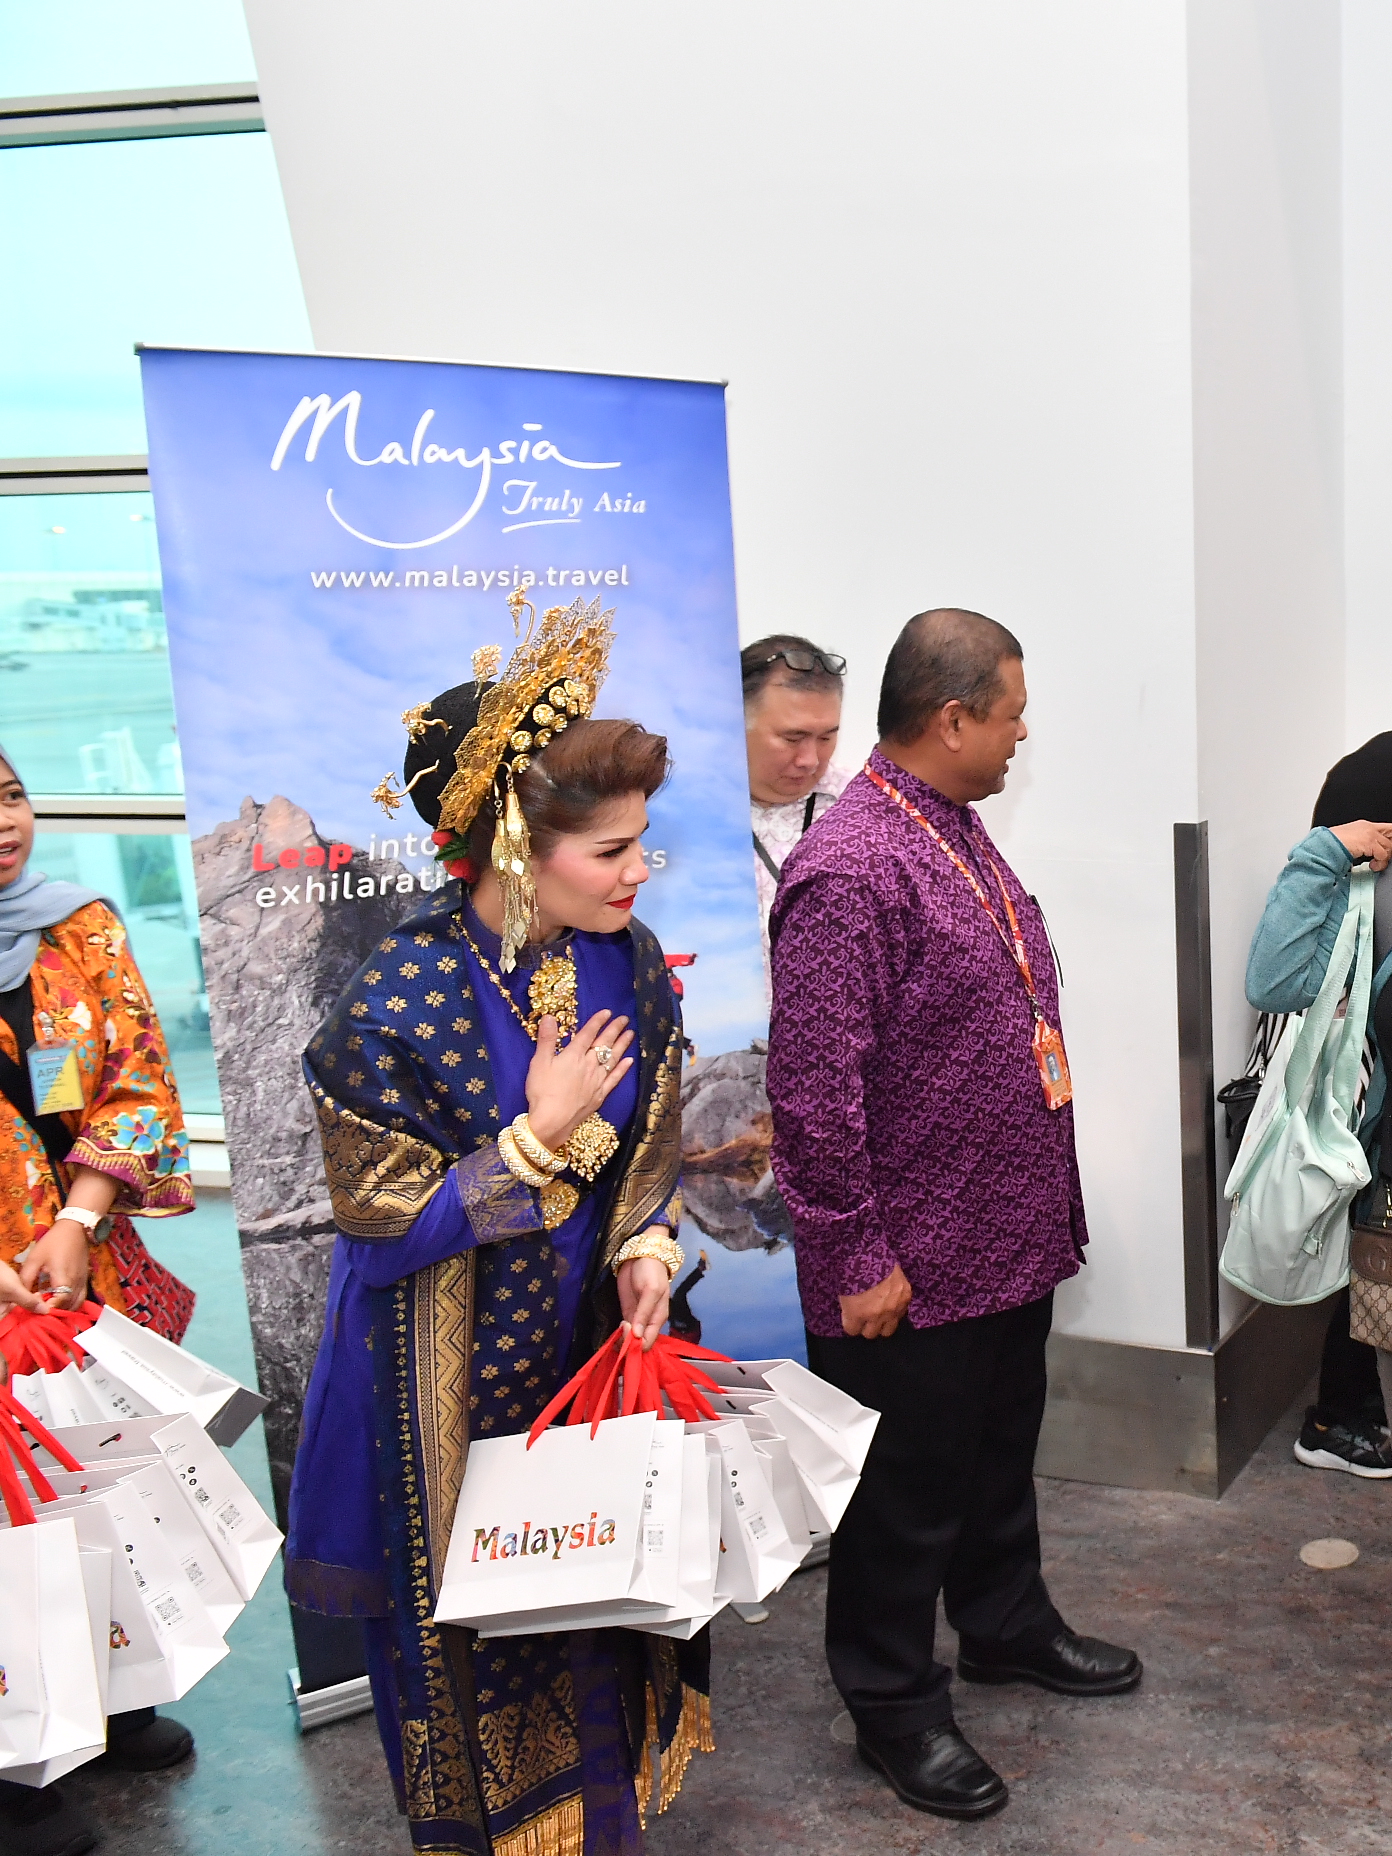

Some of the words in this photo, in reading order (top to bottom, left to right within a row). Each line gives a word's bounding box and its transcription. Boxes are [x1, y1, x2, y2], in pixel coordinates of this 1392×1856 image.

[270, 390, 622, 549] Malaysia
[502, 479, 583, 518] Truly
[593, 491, 647, 514] Asia
[310, 564, 629, 591] www.malaysia.travel
[252, 843, 353, 872] Leap
[368, 833, 440, 860] into
[471, 1511, 617, 1563] Malaysia
